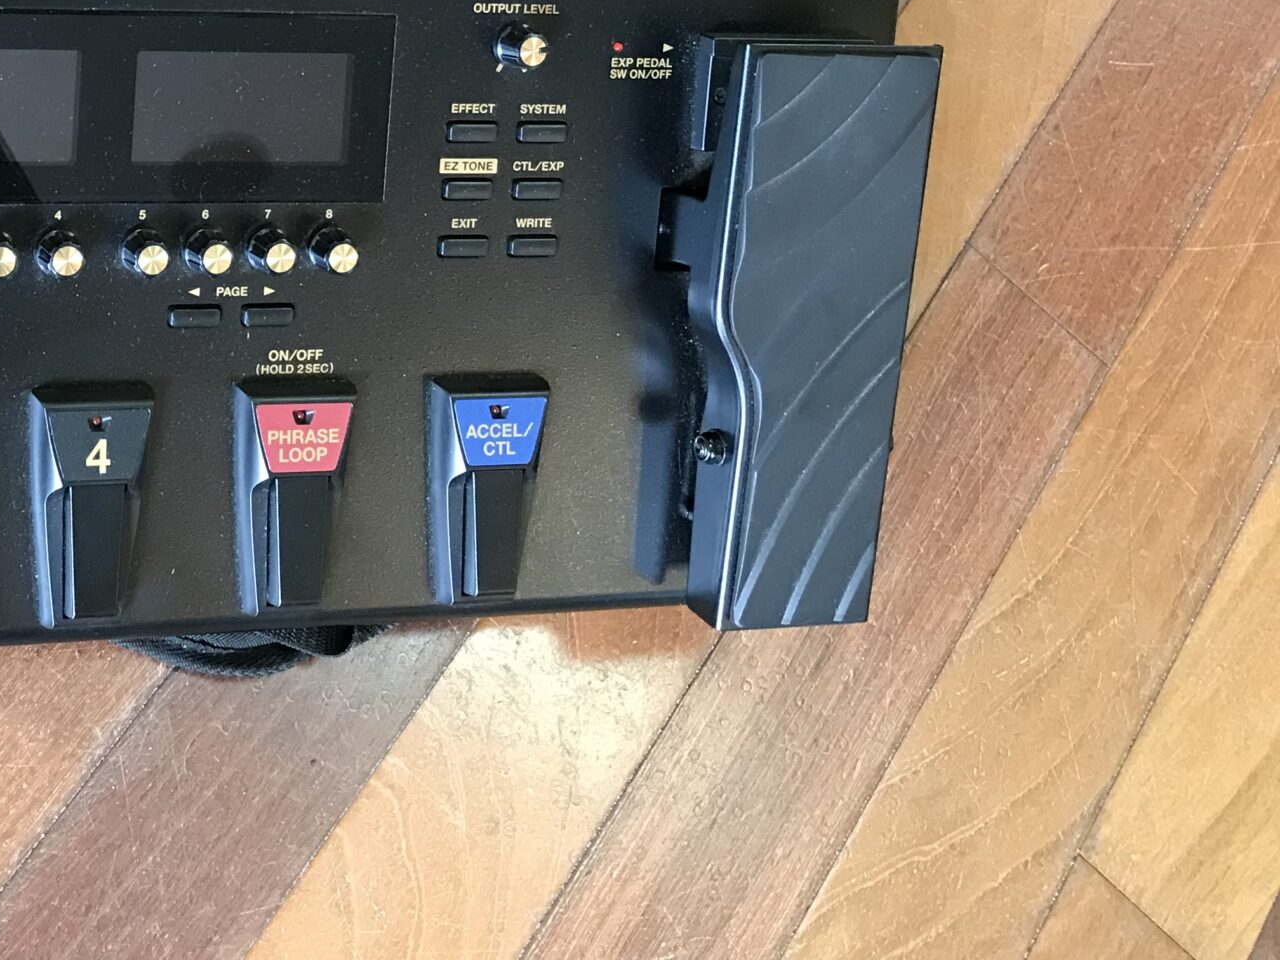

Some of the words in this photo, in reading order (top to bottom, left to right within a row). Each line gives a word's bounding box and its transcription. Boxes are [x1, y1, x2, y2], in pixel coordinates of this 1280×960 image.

[473, 2, 522, 14] OUTPUT
[523, 3, 560, 15] LEVEL
[610, 57, 634, 68] EXP
[636, 57, 673, 68] PEDAL
[609, 68, 628, 80] SW
[629, 68, 673, 80] ON/OFF
[451, 103, 496, 114] EFFECT
[519, 103, 567, 115] SYSTEM
[443, 161, 459, 171] EZ
[461, 161, 494, 171] TONE
[512, 160, 565, 172] CTL/EXP
[54, 210, 62, 221] 4
[138, 209, 147, 220] 5
[201, 209, 210, 220] 6
[264, 209, 272, 219] 7
[325, 208, 333, 219] 8
[451, 218, 478, 229] EXIT
[515, 217, 553, 228] WRITE
[215, 286, 249, 297] PAGE
[268, 348, 324, 362] ON/OFF
[466, 422, 534, 438] ACCEL/
[267, 429, 340, 445] PHRASE
[483, 441, 516, 456] CTL
[85, 438, 111, 475] 4
[278, 447, 328, 463] LOOP
